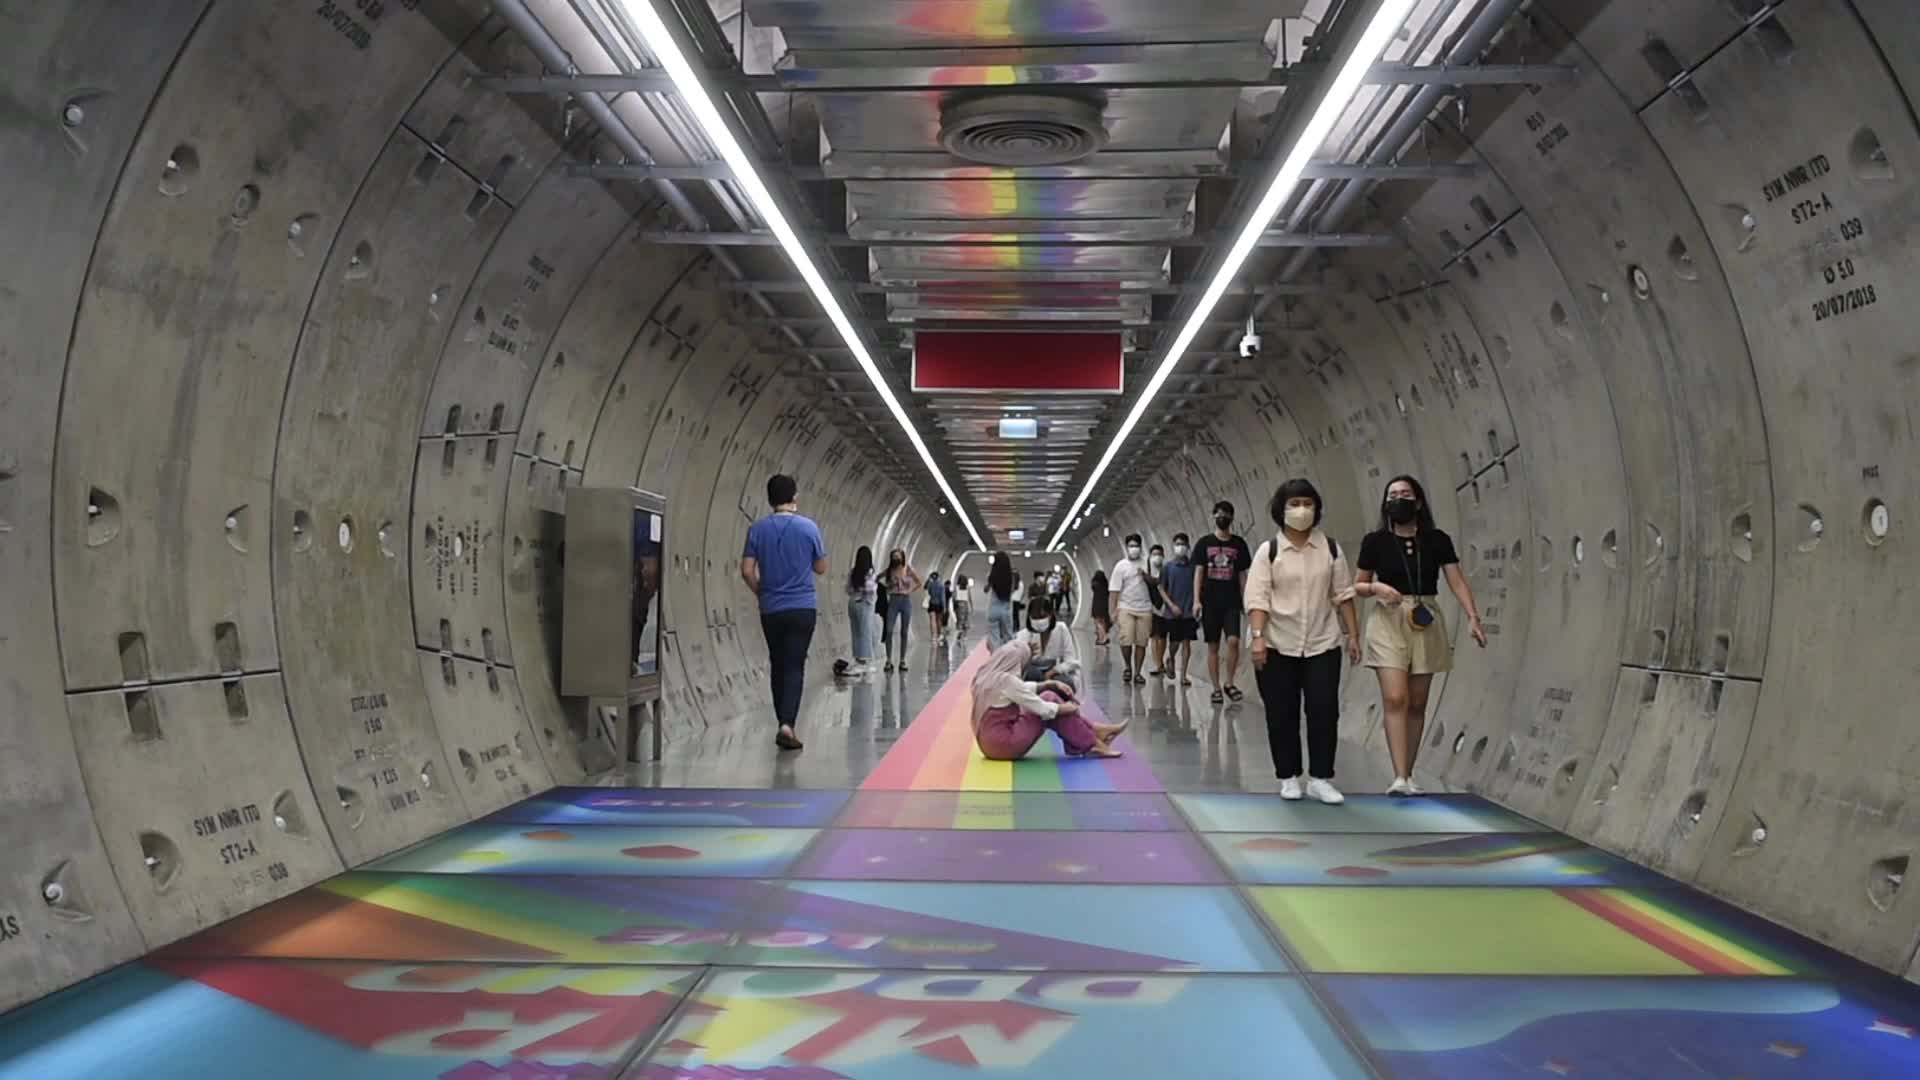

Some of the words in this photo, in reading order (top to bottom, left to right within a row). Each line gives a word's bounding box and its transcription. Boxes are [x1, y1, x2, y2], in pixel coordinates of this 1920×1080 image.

[1791, 192, 1833, 224] ST2-A
[1839, 217, 1864, 241] 039
[1812, 284, 1877, 321] 20/07/2018
[220, 839, 258, 864] ST2-A
